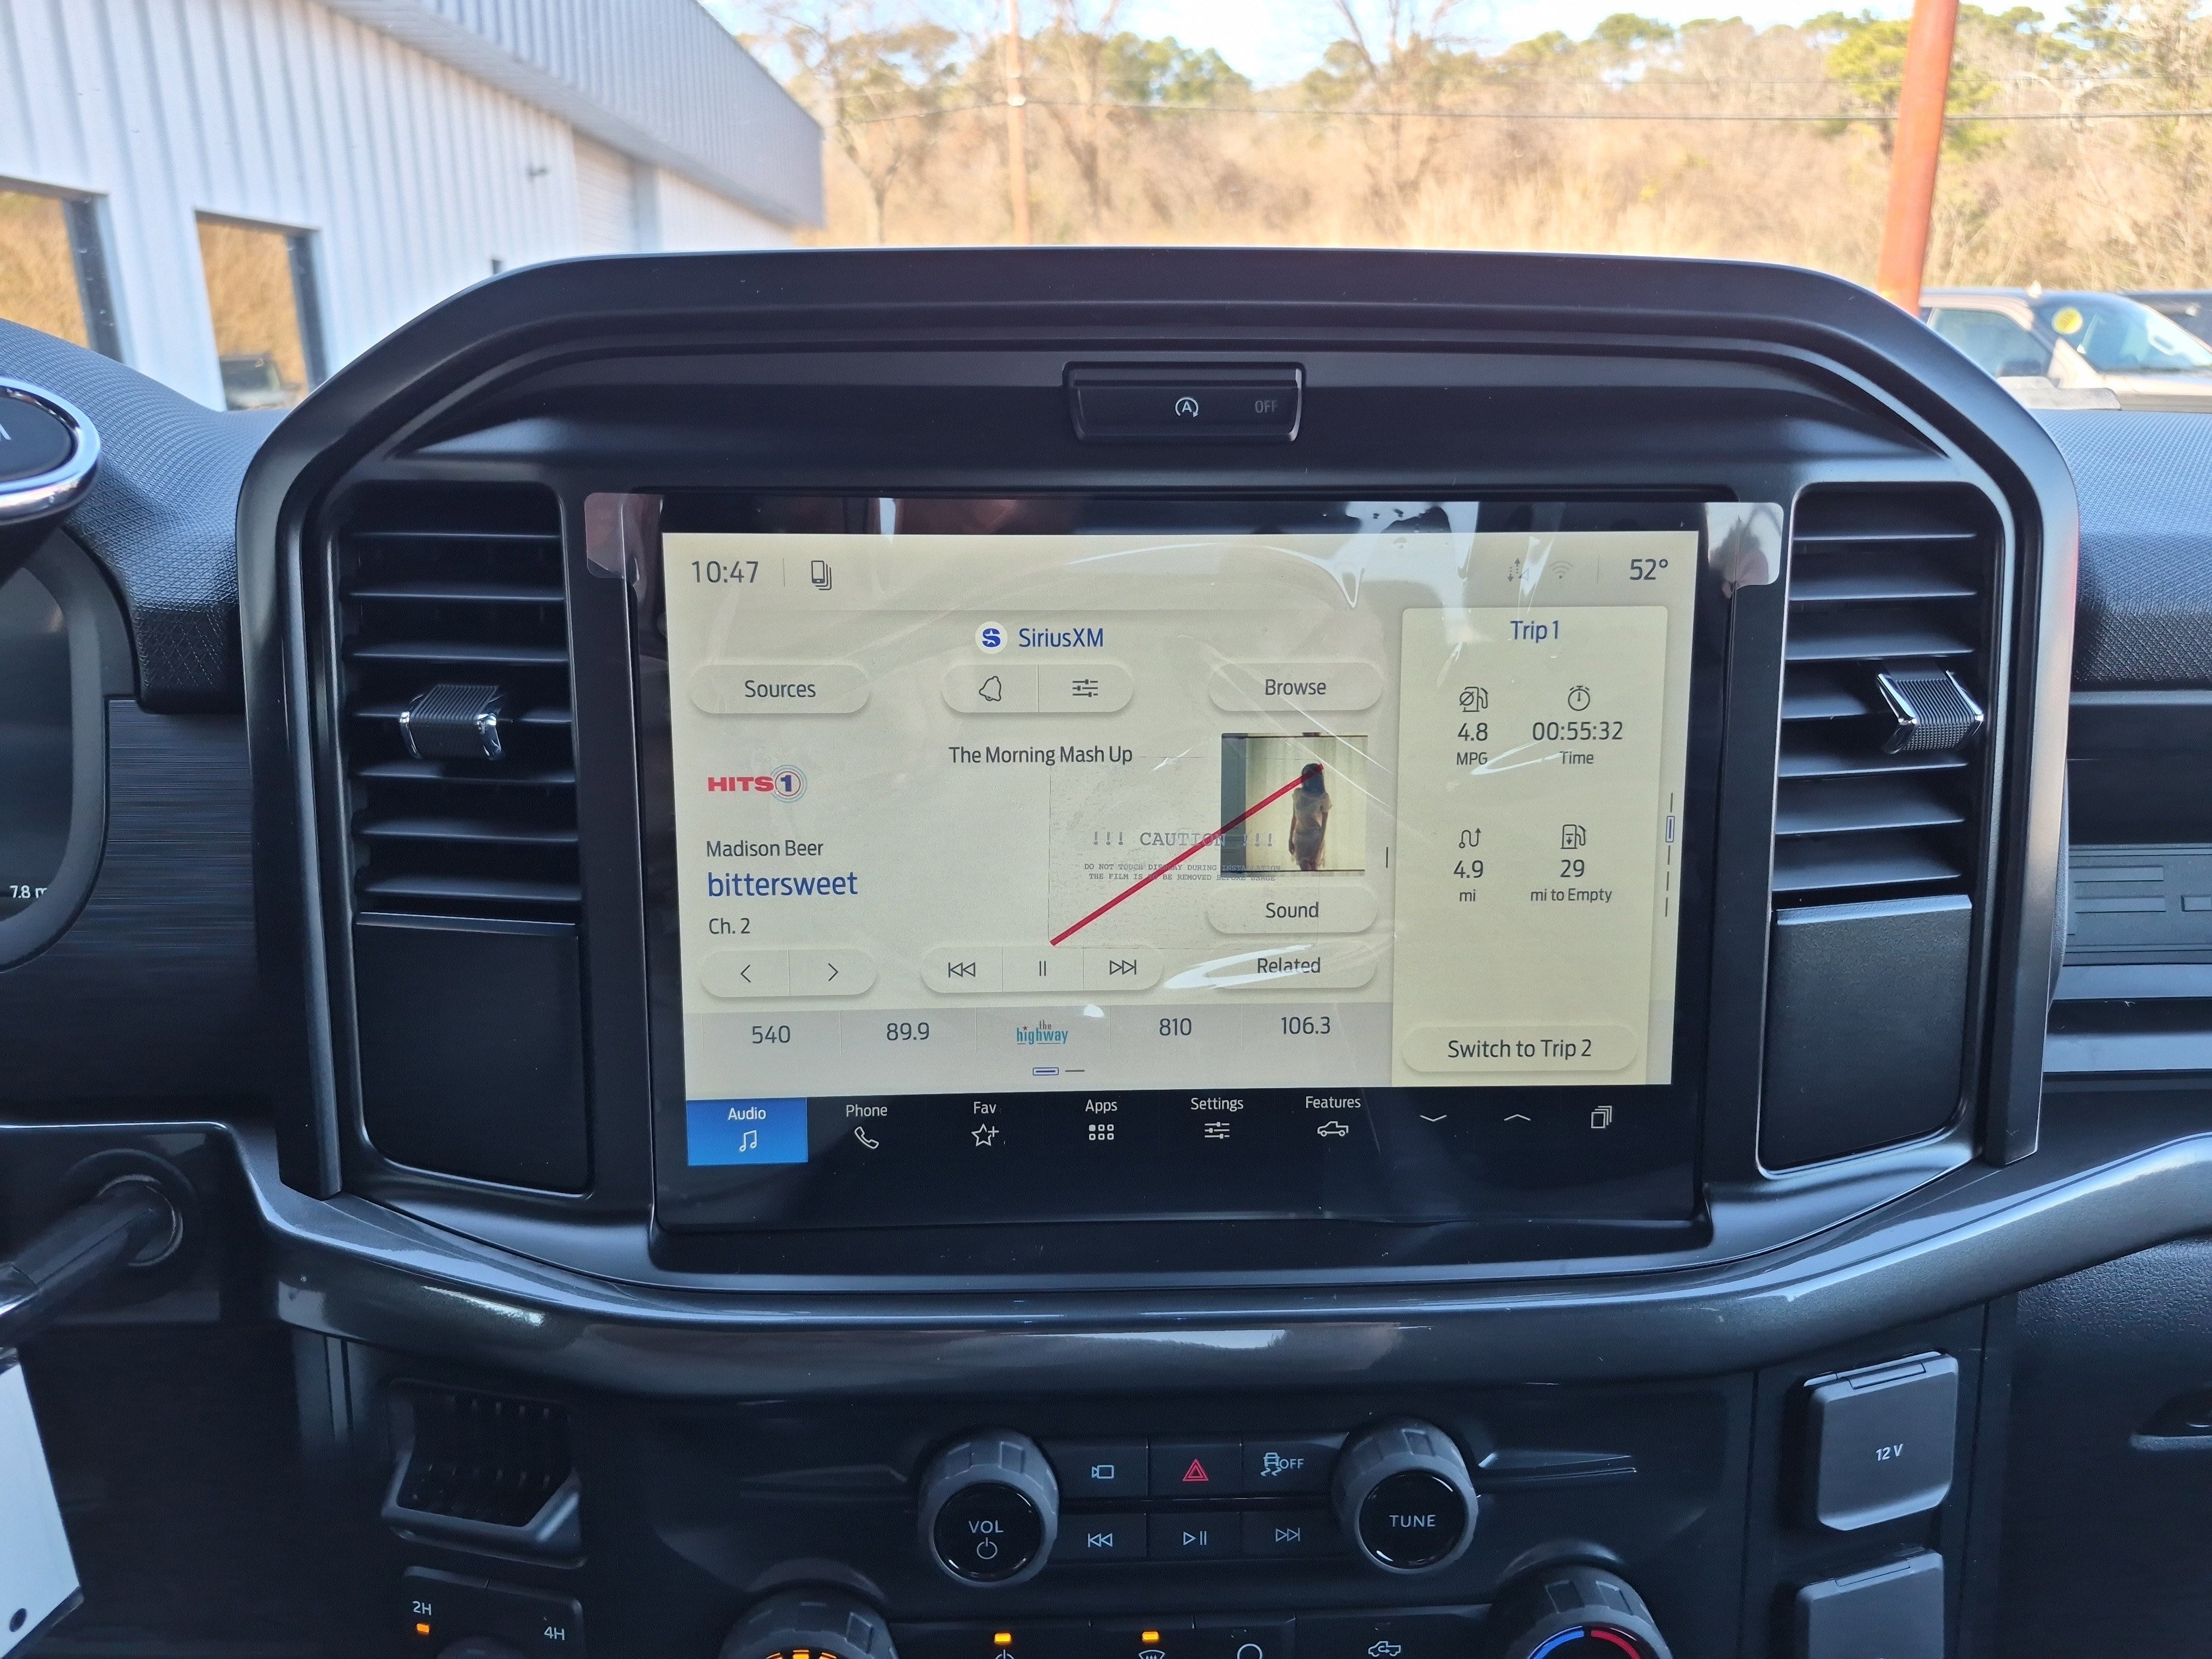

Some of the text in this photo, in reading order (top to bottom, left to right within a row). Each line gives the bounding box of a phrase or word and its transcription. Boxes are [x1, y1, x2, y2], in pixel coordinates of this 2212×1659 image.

[1255, 400, 1278, 414] OFF
[691, 561, 758, 583] 10:47
[1629, 558, 1669, 581] 52°
[1018, 627, 1104, 648] SiriusXM
[1510, 620, 1559, 643] Trip 1
[744, 680, 816, 698] Sources
[1265, 678, 1327, 696] Browse
[1457, 722, 1488, 742] 4.8
[1532, 721, 1623, 741] 00:55:32
[948, 745, 1133, 766] The Morning Mash Up
[1456, 752, 1488, 766] MPG
[1560, 751, 1594, 765] Time
[708, 776, 774, 792] HITS
[1093, 831, 1123, 845] !!!
[1140, 832, 1226, 846] CAUTION
[706, 839, 824, 857] Madison Beer
[1117, 863, 1143, 871] TOUCH
[1147, 863, 1184, 871] DISAY
[1186, 864, 1218, 872] DURING
[1453, 860, 1483, 879] 4.9
[1560, 859, 1585, 878] 29
[9, 885, 48, 899] 7.8 m
[708, 871, 858, 897] bittersweet
[1459, 890, 1476, 902] mi
[1531, 888, 1612, 903] mi to Empty
[1265, 901, 1319, 918] Sound
[709, 917, 750, 935] Ch. 2
[1257, 957, 1321, 974] Related
[886, 1022, 929, 1041] 89.9
[1038, 1019, 1053, 1031] the
[1159, 1018, 1192, 1036] 810
[1281, 1016, 1330, 1034] 106.3
[752, 1025, 790, 1044] 540
[1016, 1029, 1069, 1045] highway
[1448, 1039, 1591, 1060] Switch to Trip 2
[846, 1104, 888, 1117] Phone
[974, 1101, 996, 1114] Fav
[1085, 1099, 1118, 1114] Apps
[1191, 1097, 1244, 1112] Settings
[1306, 1096, 1361, 1109] Features
[728, 1107, 766, 1121] Audio
[1876, 1443, 1904, 1461] 12 V
[1278, 1458, 1304, 1469] OFF
[968, 1520, 1004, 1534] VOL
[1389, 1514, 1436, 1528] TUNE
[412, 1600, 432, 1616] 2H
[544, 1626, 565, 1641] 4H
